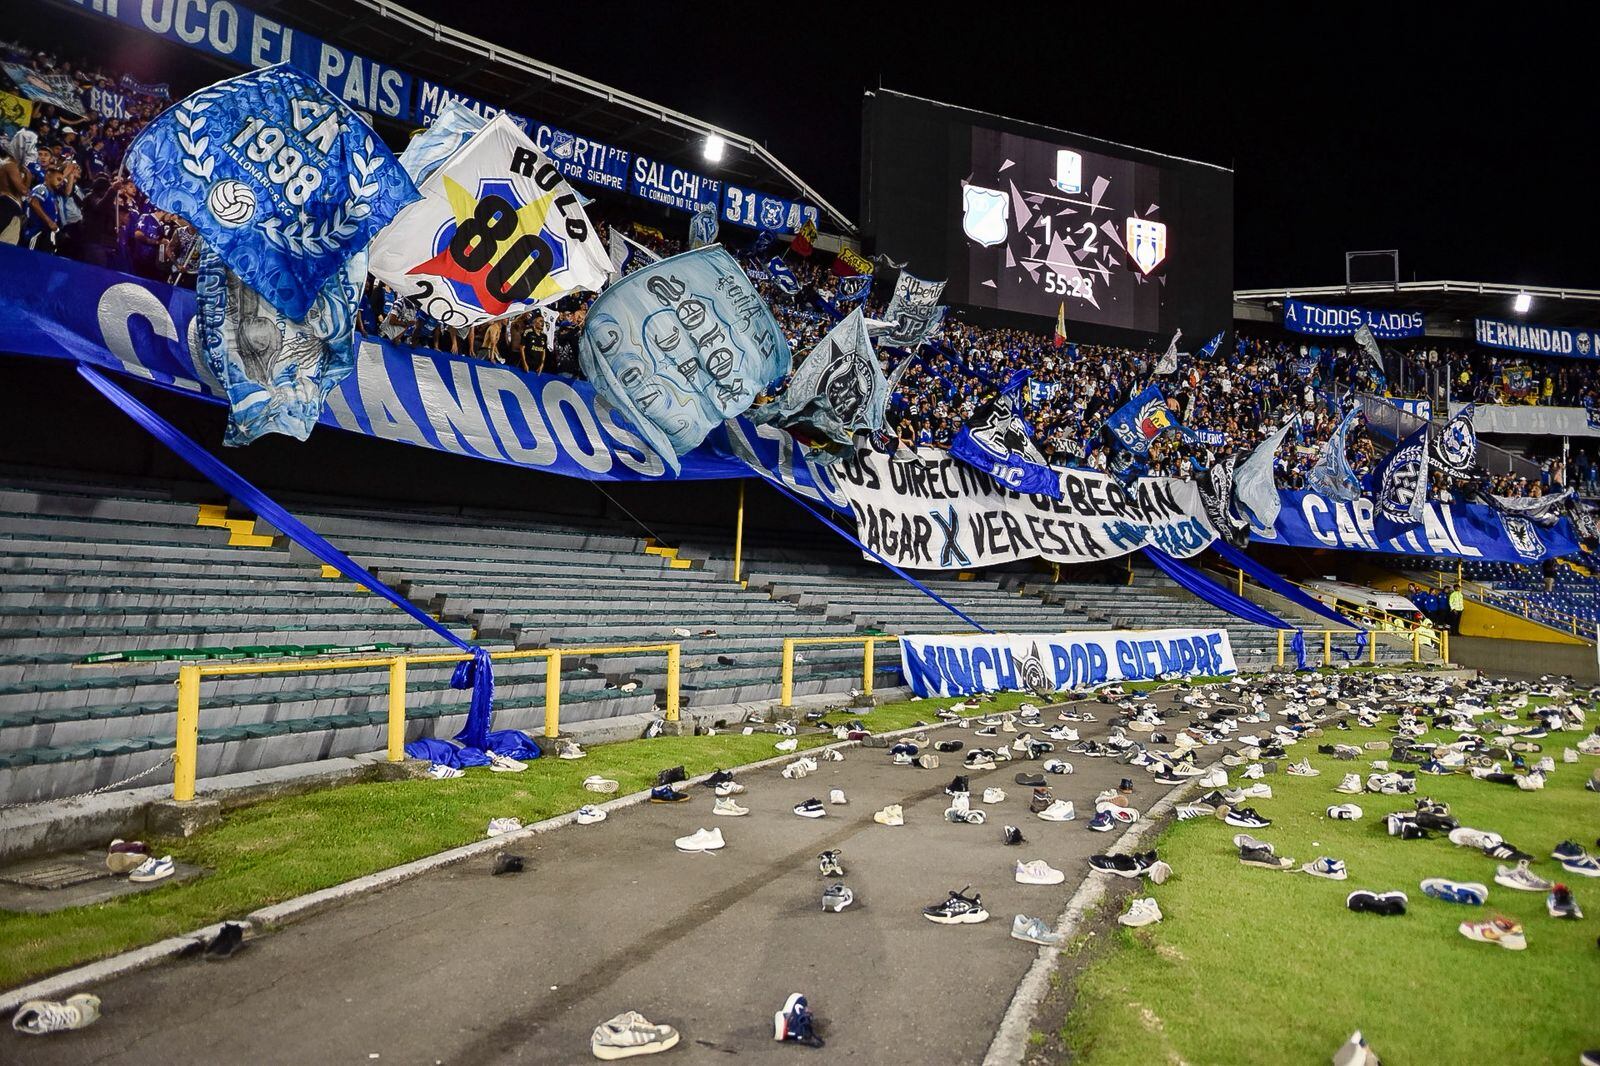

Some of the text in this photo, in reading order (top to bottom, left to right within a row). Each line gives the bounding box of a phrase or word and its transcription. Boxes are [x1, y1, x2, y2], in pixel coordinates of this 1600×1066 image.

[318, 42, 403, 117] PAIS
[221, 142, 281, 203] MILLONARIOS
[232, 116, 323, 206] 1998
[564, 162, 583, 178] POR
[587, 169, 623, 190] SIEMPRE
[609, 147, 628, 163] PTE
[634, 156, 719, 200] SALCHI PTE
[640, 185, 648, 198] EL
[649, 189, 675, 206] COMANDO
[676, 195, 684, 208] NO
[726, 187, 757, 227] 31
[449, 194, 554, 303] 80
[1044, 272, 1093, 299] 55:23
[1285, 303, 1423, 331] A TODOS LADOS
[1475, 318, 1573, 354] HERMANDAD
[97, 282, 665, 478] CANDOS
[888, 456, 1021, 500] DIRECTIV
[929, 504, 972, 567] X
[968, 511, 1034, 559] VER
[1024, 513, 1106, 559] ESTA
[1302, 493, 1484, 557] CAPAL
[1049, 642, 1107, 690] POR
[1116, 632, 1236, 681] SIEMPRE
